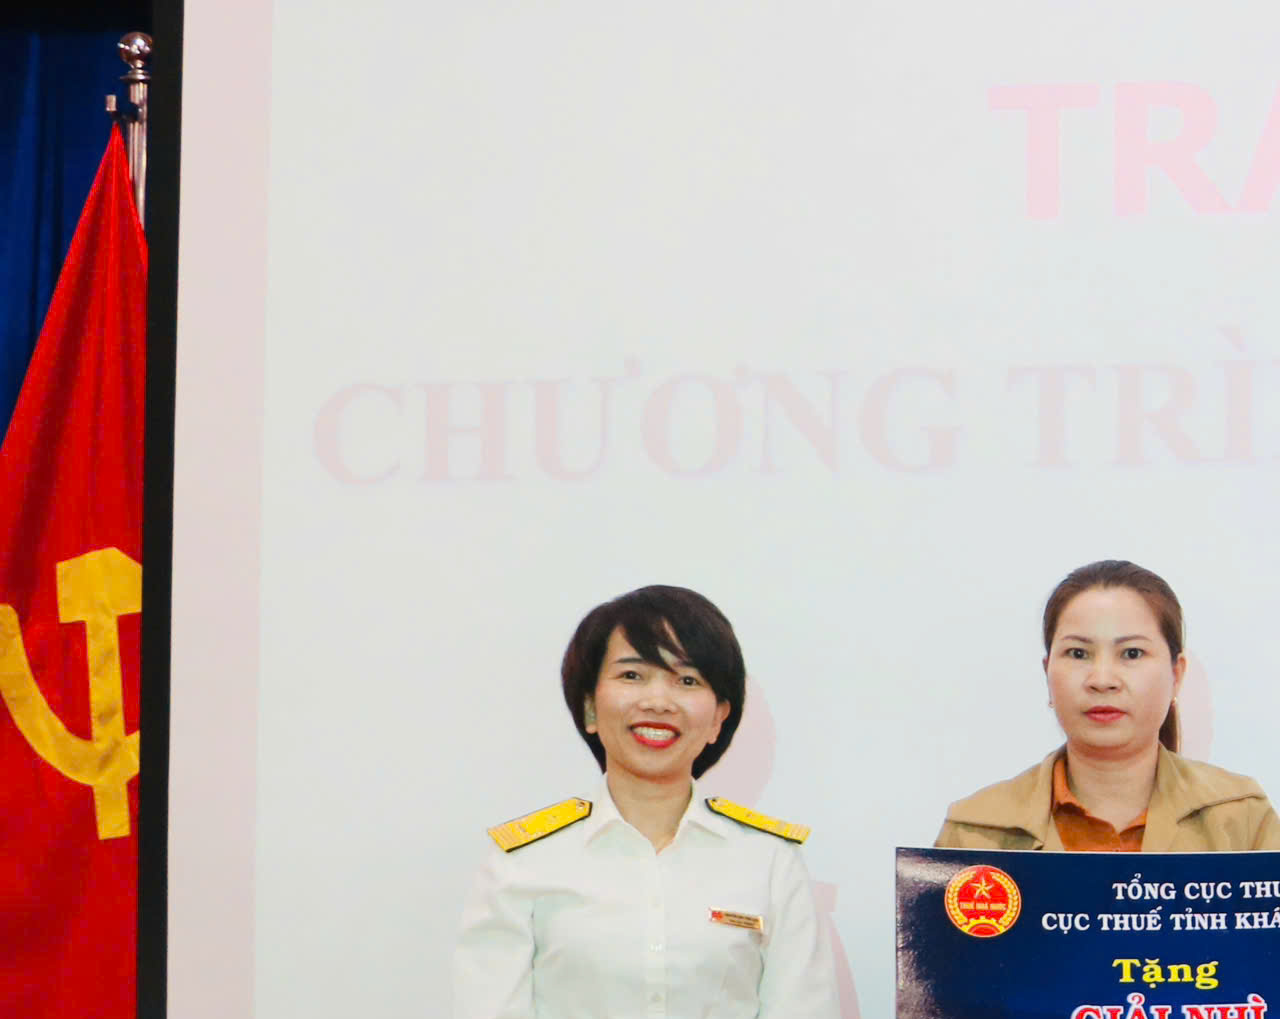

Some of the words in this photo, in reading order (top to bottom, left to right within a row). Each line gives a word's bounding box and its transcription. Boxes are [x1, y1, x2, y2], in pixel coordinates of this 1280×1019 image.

[312, 354, 964, 484] CHƯƠNG
[1112, 872, 1176, 901] TỔNG
[1184, 880, 1232, 904] CỤC
[1041, 913, 1090, 935] CỤC
[1097, 905, 1163, 932] THUẾ
[1172, 907, 1227, 932] TỈNH
[1112, 957, 1219, 989] Tặng
